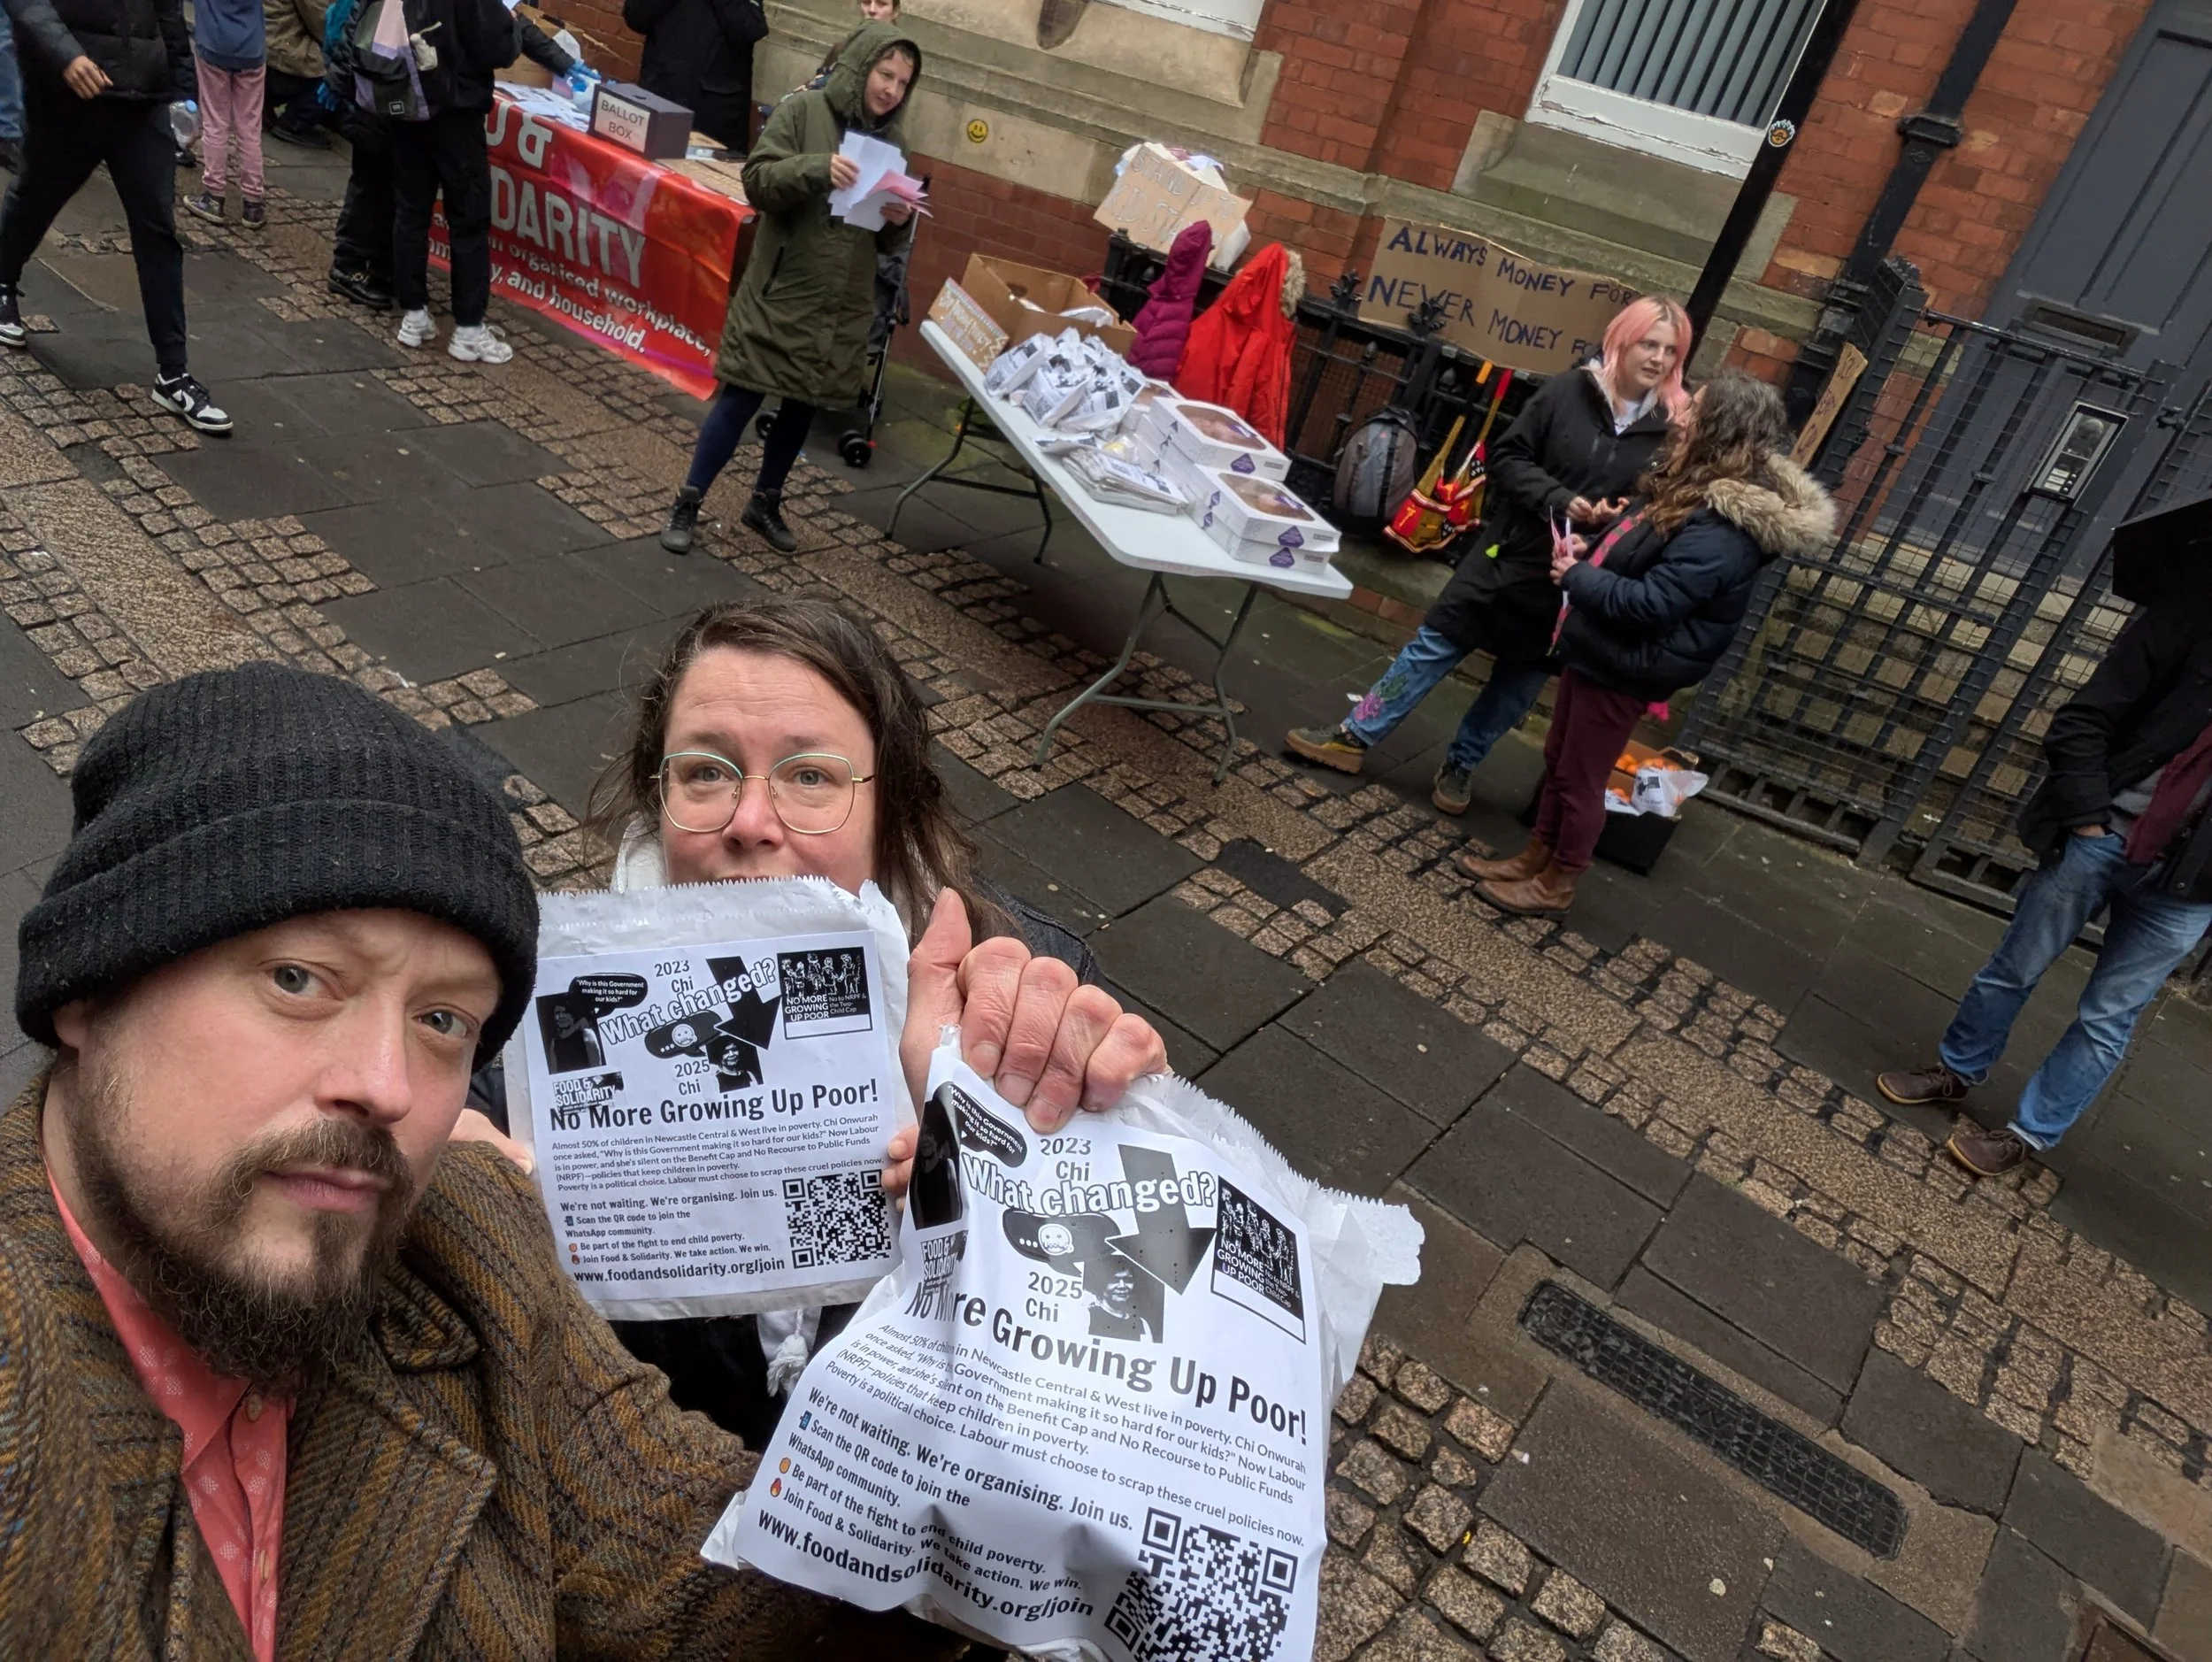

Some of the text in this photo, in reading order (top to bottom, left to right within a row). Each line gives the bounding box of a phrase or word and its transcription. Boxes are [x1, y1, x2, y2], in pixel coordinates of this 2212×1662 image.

[601, 99, 646, 127] BALLOT
[608, 120, 634, 142] BOX
[490, 165, 646, 289] DARITY
[1387, 227, 1633, 305] ALWAYS MONEY FOR
[507, 270, 645, 353] and household.
[1487, 310, 1563, 350] MONEY
[654, 959, 690, 978] 2023
[671, 976, 695, 994] Chi
[598, 957, 778, 1046] What changed?
[785, 1003, 829, 1014] GROWING
[787, 994, 828, 1005] NO MORE
[803, 1011, 830, 1020] POOR
[674, 1060, 710, 1078] 2025
[553, 1080, 581, 1095] FOOD
[556, 1085, 616, 1107] SOLIDARITY
[678, 1079, 702, 1096] Chi
[549, 1108, 580, 1131] No
[589, 1104, 652, 1129] More
[661, 1094, 764, 1121] Growing
[772, 1089, 803, 1116] Up
[813, 1079, 879, 1109] Poor!
[551, 1141, 580, 1150] Almost
[610, 1136, 643, 1145] children
[654, 1132, 696, 1142] Newcastle
[697, 1129, 728, 1138] Central
[738, 1126, 760, 1135] West
[787, 1120, 822, 1132] poverty.
[839, 1114, 878, 1125] Onwurah
[573, 1150, 599, 1160] asked,
[649, 1143, 700, 1153] Government
[702, 1140, 732, 1150] making
[849, 1126, 879, 1135] Labour
[1040, 1137, 1091, 1157] 2023
[687, 1152, 718, 1161] Benefit
[718, 1150, 735, 1160] Cap
[767, 1144, 805, 1154] Recourse
[818, 1140, 843, 1150] Public
[845, 1137, 870, 1147] Funds
[558, 1181, 589, 1192] Poverty
[605, 1179, 638, 1189] political
[639, 1176, 666, 1185] choice.
[720, 1170, 749, 1179] choose
[784, 1165, 806, 1173] these
[831, 1159, 863, 1171] policies
[641, 1168, 661, 1177] keep
[662, 1166, 695, 1174] children
[706, 1163, 740, 1173] poverty.
[961, 1150, 1217, 1217] What changed?
[1056, 1160, 1091, 1181] Chi
[1217, 1249, 1265, 1283] GROWING
[1221, 1240, 1264, 1273] NO MORE
[1028, 1271, 1083, 1300] 2025
[1222, 1262, 1265, 1295] UP POOR
[1025, 1297, 1059, 1323] Chi
[904, 1282, 1308, 1446] No More Growing Up Poor!
[787, 1432, 901, 1507] WhatsApp community.
[808, 1387, 1133, 1530] We're not waiting. We're organising. Join us.
[810, 1420, 971, 1506] Scan the QR code to join the
[791, 1464, 1047, 1574] Be part of the fight to end child poverty.
[783, 1488, 1081, 1591] Join Food & Solidarity. We take action. We win.
[758, 1509, 1094, 1623] www.foodandsolidarity.org/join
